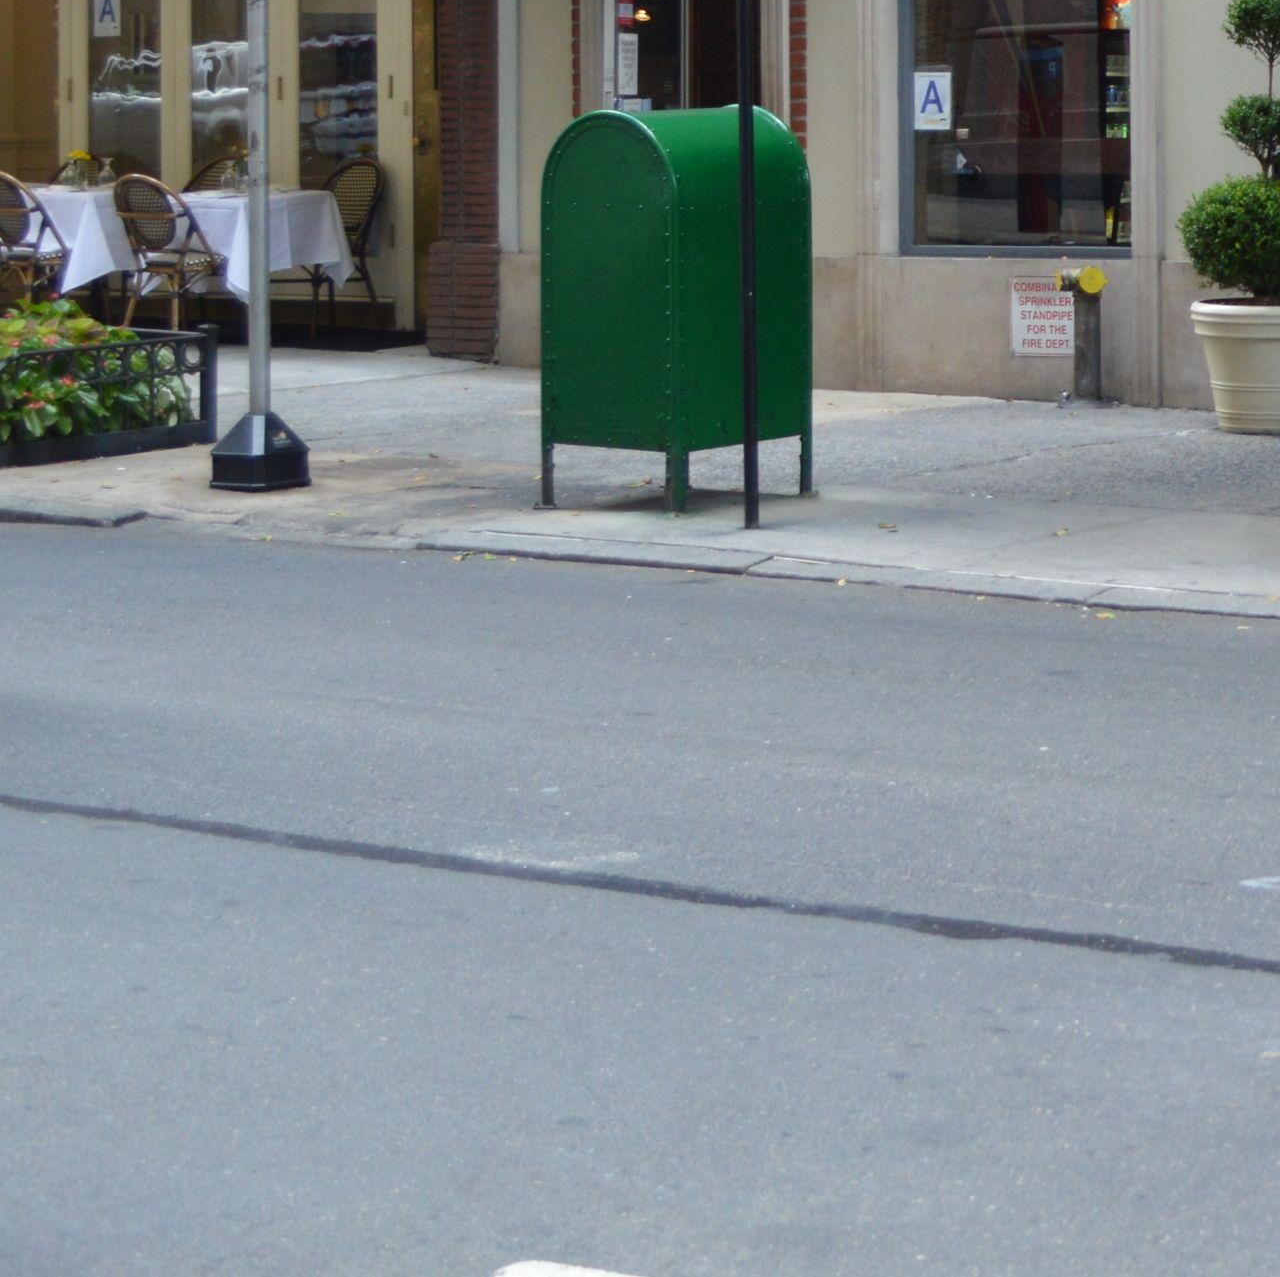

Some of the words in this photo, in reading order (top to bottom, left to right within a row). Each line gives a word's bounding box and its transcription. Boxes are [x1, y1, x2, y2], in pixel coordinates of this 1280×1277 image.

[921, 80, 944, 113] A
[1013, 282, 1058, 293] COMBINA
[1020, 310, 1073, 321] STANDPIPE
[1027, 325, 1046, 335] FOR
[1050, 325, 1068, 335] THE
[1022, 339, 1042, 349] FIRE
[1046, 339, 1073, 349] DEPT.
